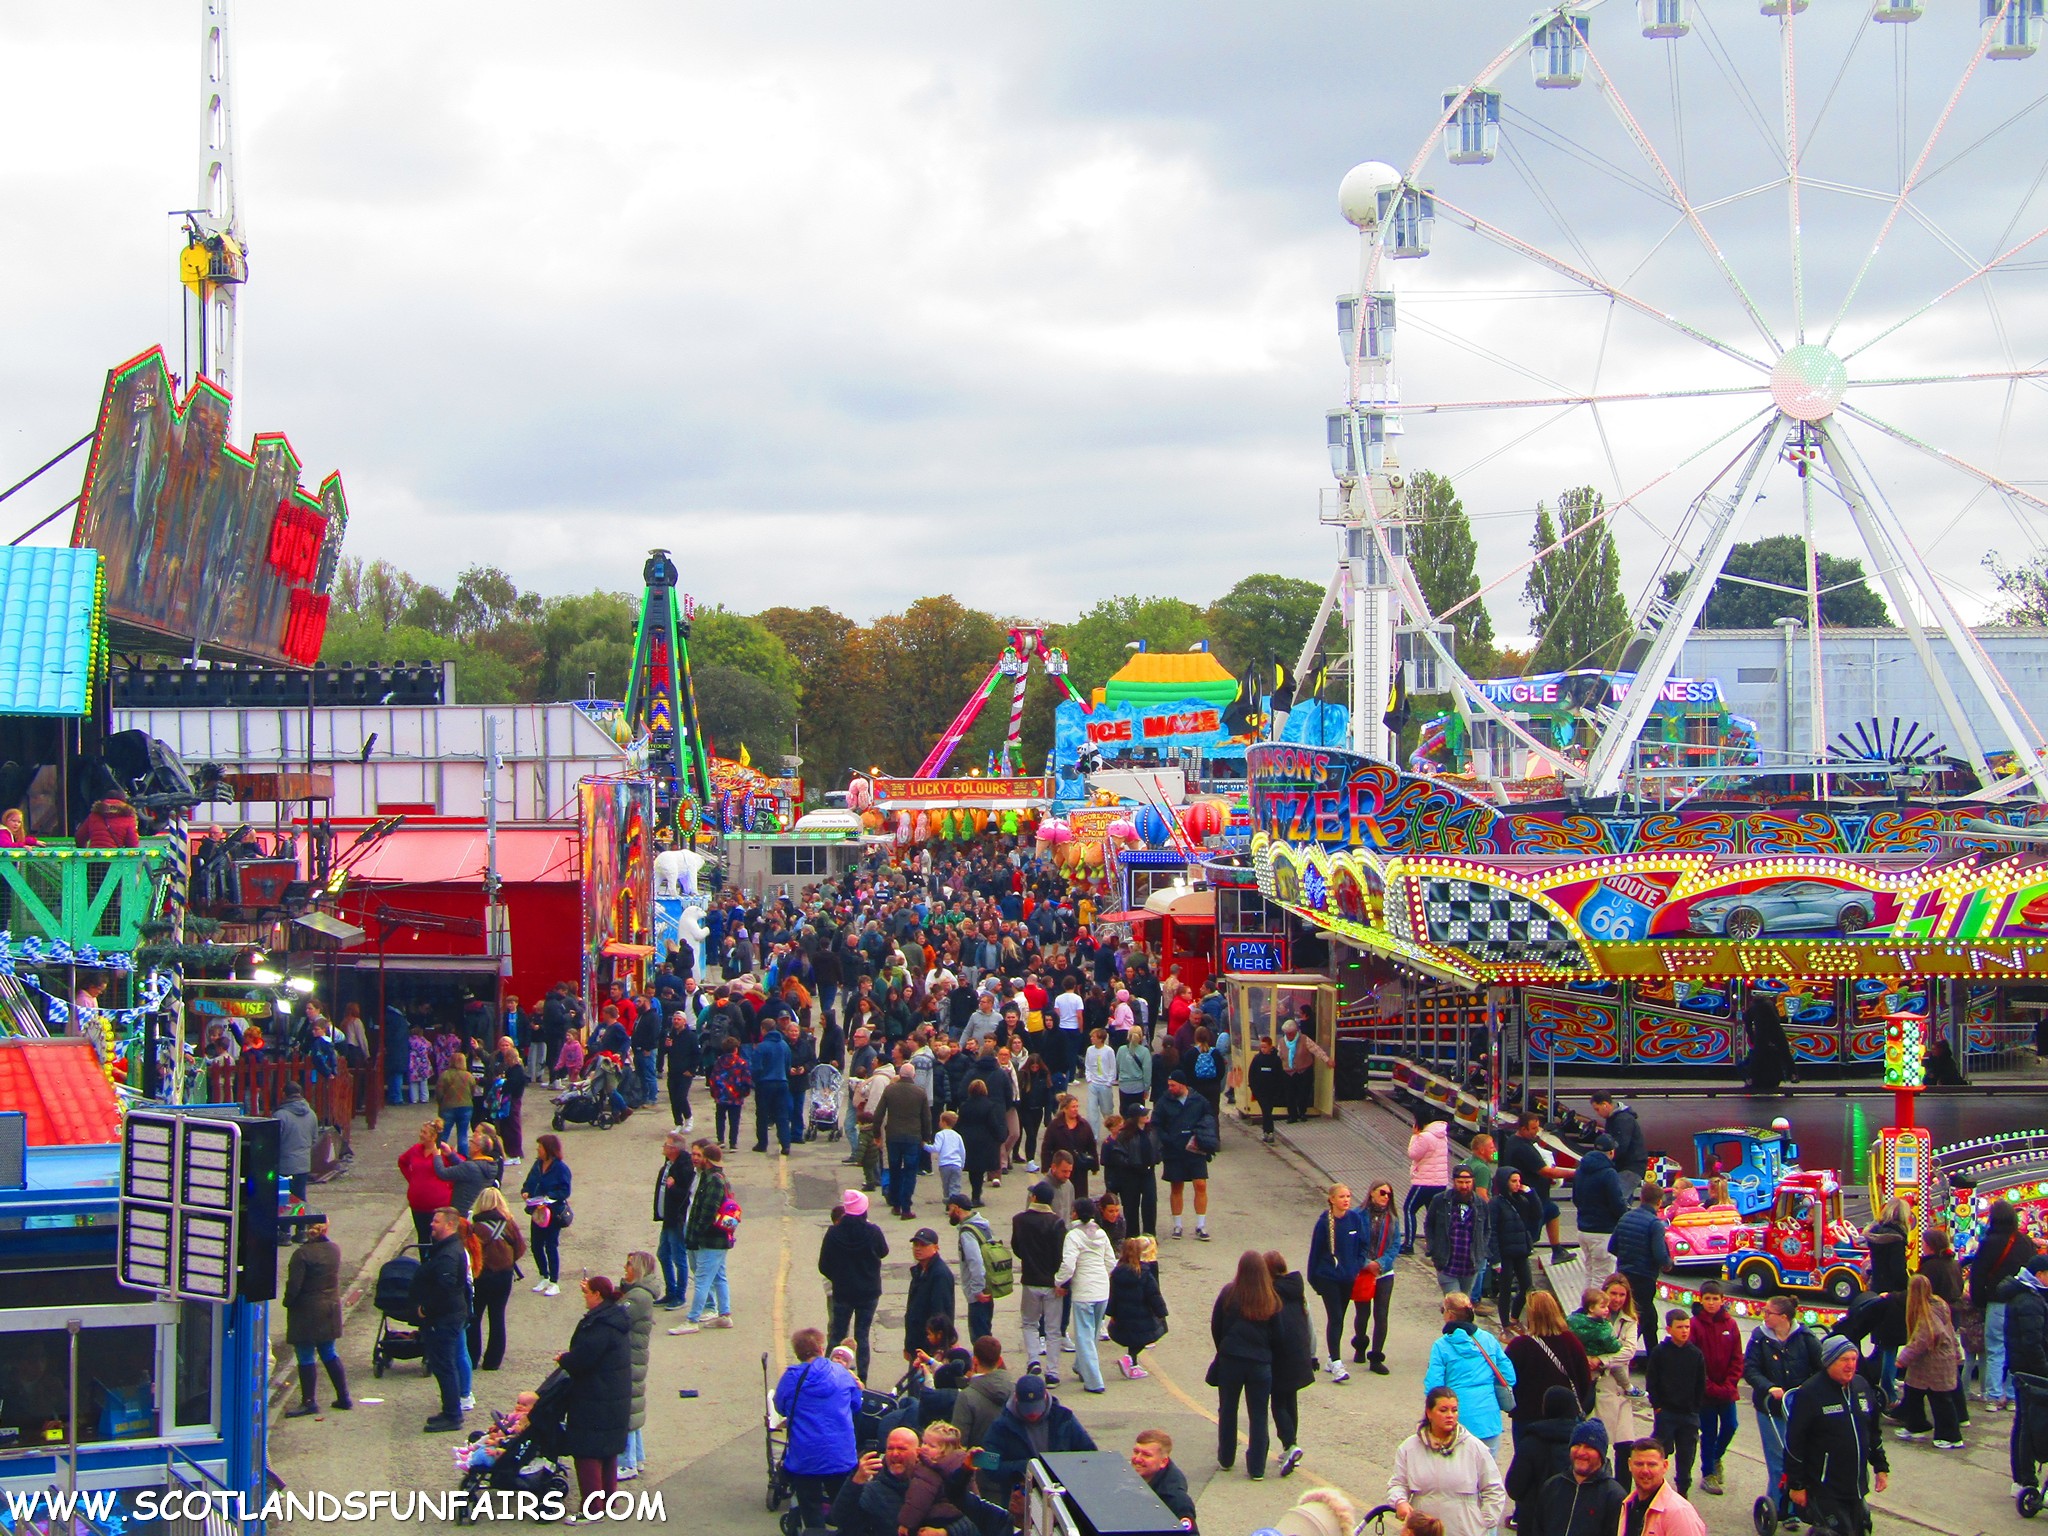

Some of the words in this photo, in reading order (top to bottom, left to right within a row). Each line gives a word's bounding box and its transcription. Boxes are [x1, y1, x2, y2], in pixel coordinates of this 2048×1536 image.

[1613, 683, 1713, 701] MNESS
[1086, 720, 1132, 744] ICE
[1143, 710, 1220, 738] MAZE
[911, 783, 948, 796] LUCKY
[953, 783, 1007, 795] COLOURS
[755, 798, 775, 812] XIC
[1096, 820, 1106, 830] 10
[1605, 875, 1660, 907] ROUTE
[1590, 905, 1635, 941] 66
[1240, 943, 1267, 954] PAY
[1233, 958, 1272, 970] HERE
